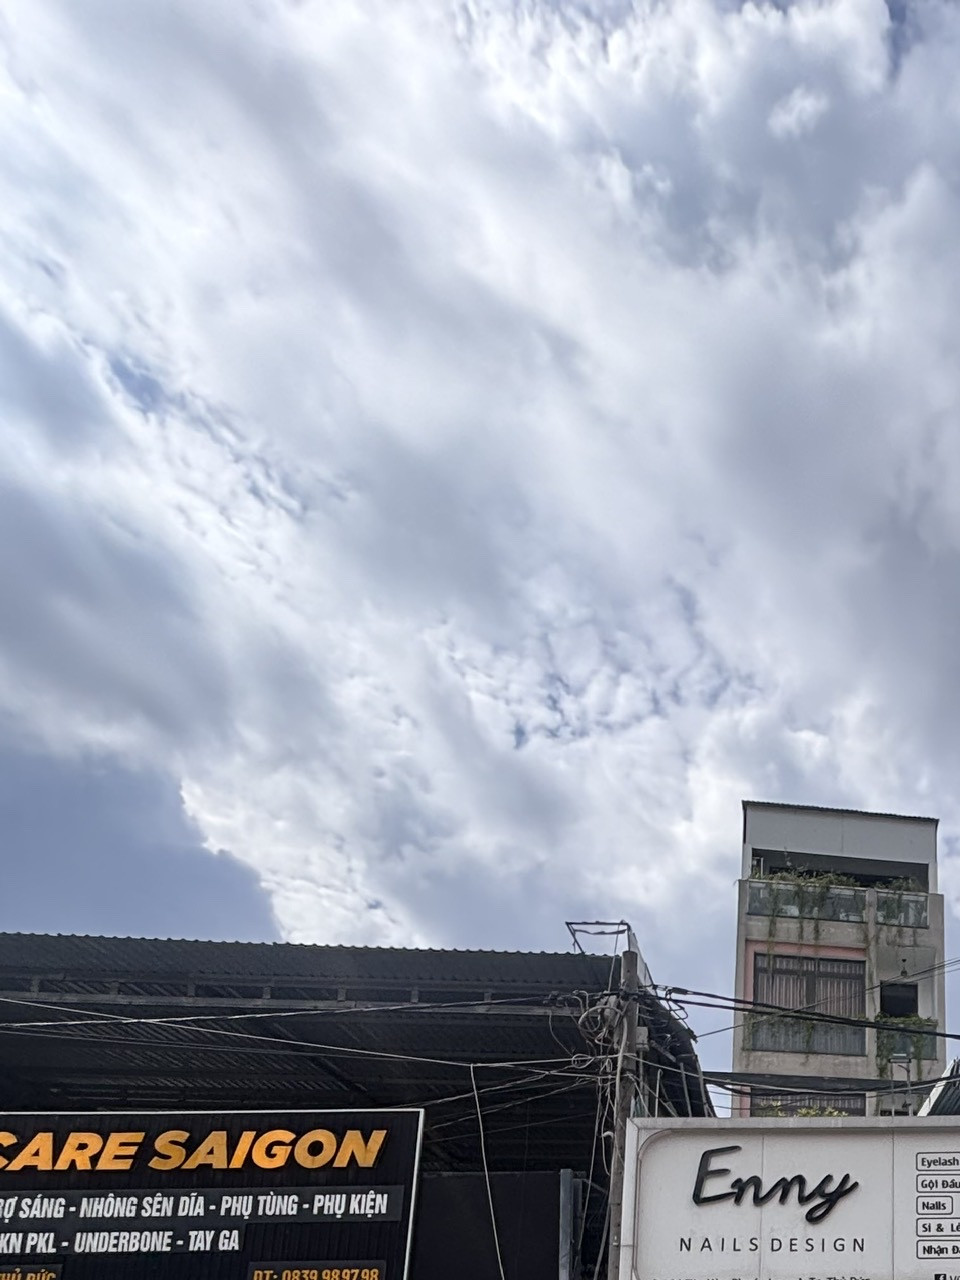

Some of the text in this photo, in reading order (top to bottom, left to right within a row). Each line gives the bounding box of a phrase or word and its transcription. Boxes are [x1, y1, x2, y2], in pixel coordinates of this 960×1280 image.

[148, 1128, 389, 1170] SAIGON
[921, 1157, 959, 1168] Eyelash
[692, 1145, 860, 1225] Enny
[921, 1179, 938, 1190] Gội
[19, 1193, 66, 1219] SÁNG
[80, 1192, 138, 1218] NHÔNG
[141, 1192, 176, 1218] SÊN
[178, 1191, 205, 1217] DĨA
[220, 1194, 252, 1219] PHỤ
[257, 1191, 298, 1216] TÙNG
[312, 1193, 346, 1219] PHỤ
[349, 1190, 388, 1218] KIỆN
[922, 1201, 946, 1211] Nails
[936, 1223, 944, 1232] &
[25, 1232, 57, 1254] PKL
[73, 1230, 172, 1254] UNDERBONE
[188, 1230, 215, 1251] TAY
[218, 1230, 239, 1251] GA
[679, 1237, 865, 1252] NAILS DESIGN
[922, 1245, 948, 1256] Nhận
